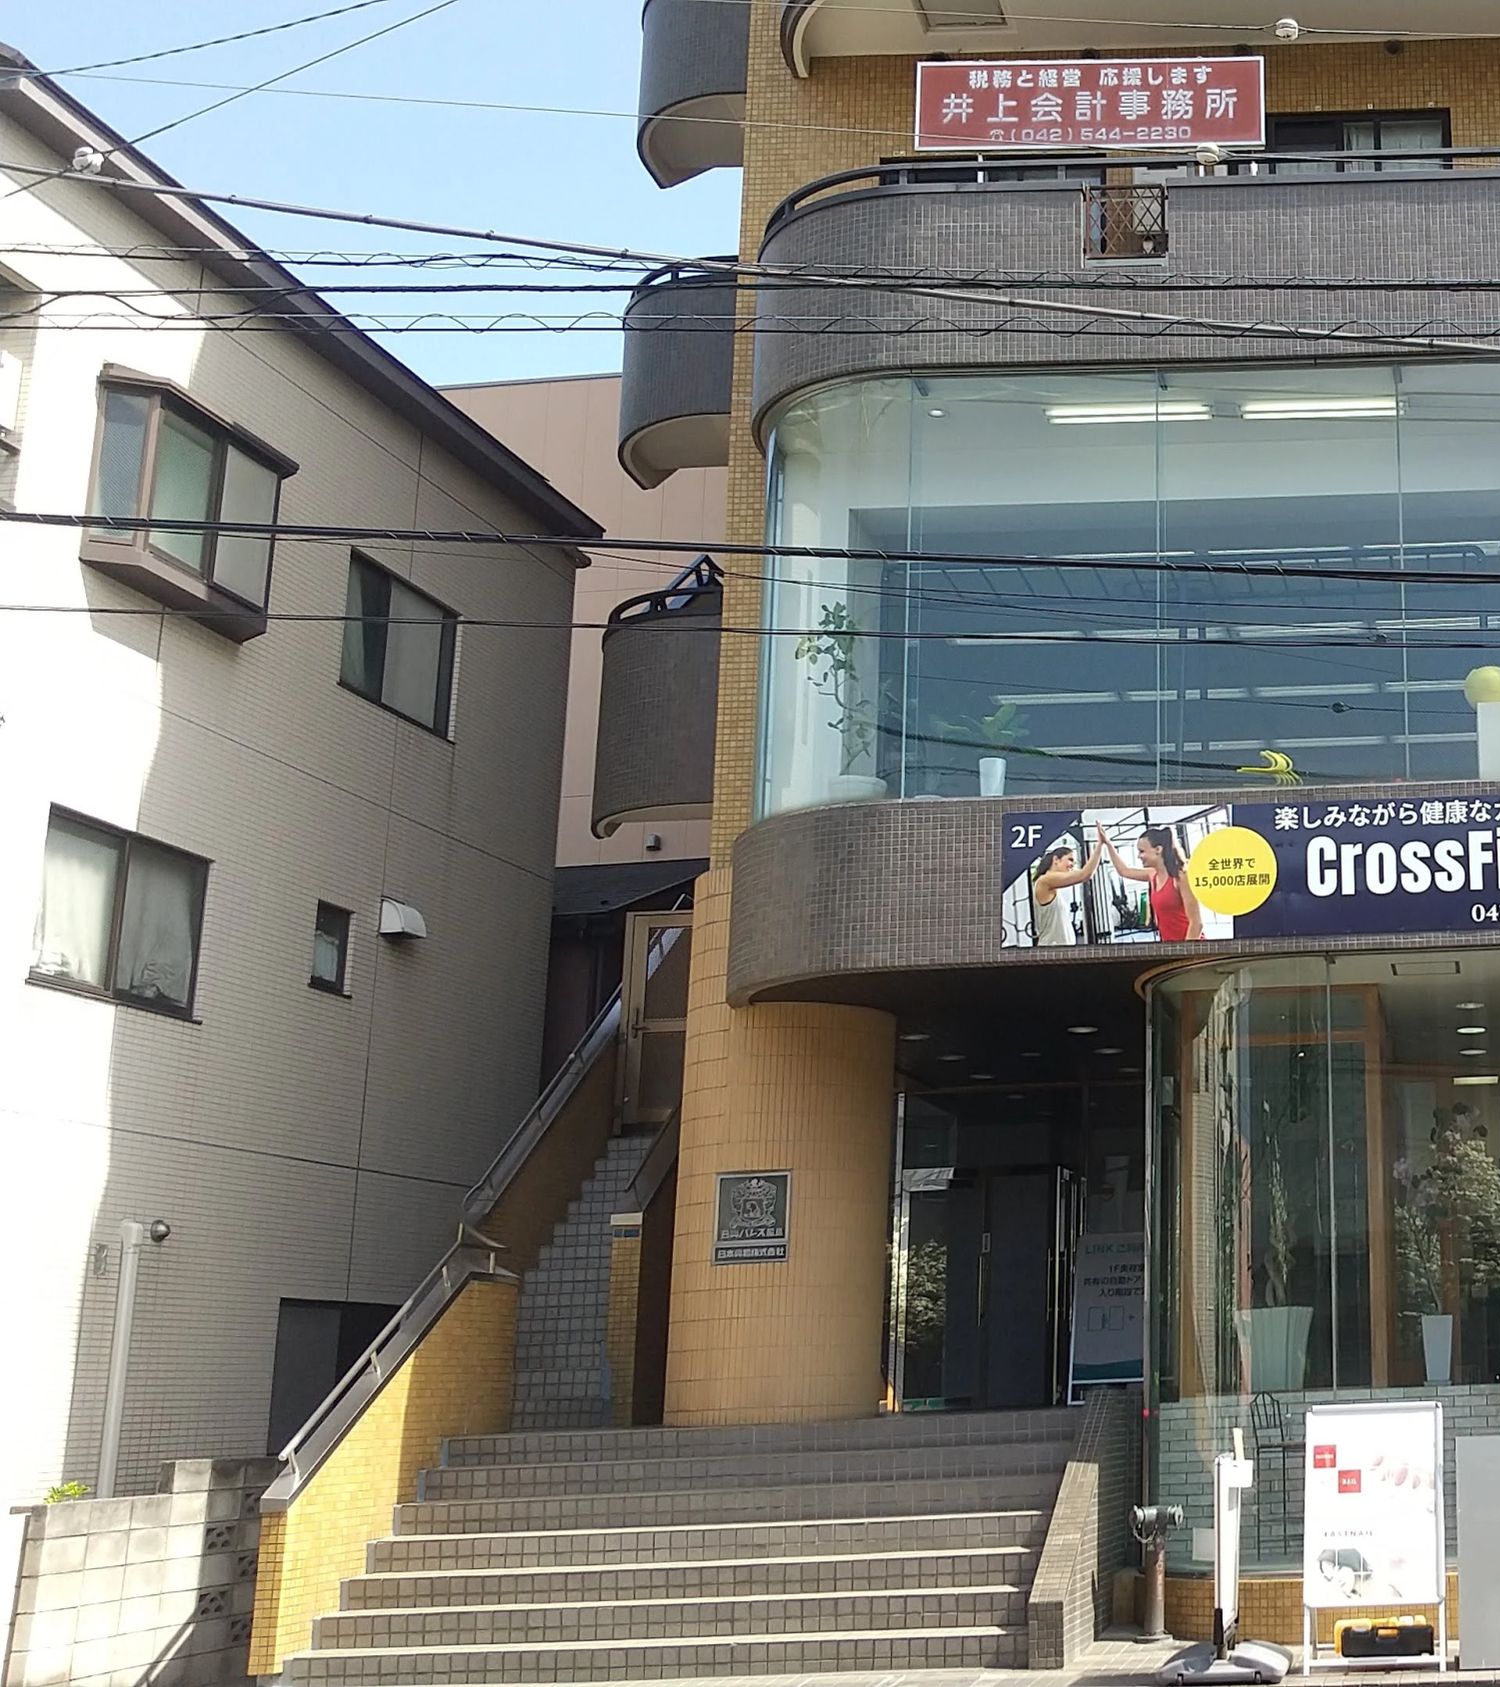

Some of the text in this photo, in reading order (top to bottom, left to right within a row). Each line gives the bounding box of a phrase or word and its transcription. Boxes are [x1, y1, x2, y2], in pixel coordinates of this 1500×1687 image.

[969, 66, 1213, 89] 税務と経営 応援します
[942, 88, 1239, 124] 井上会計事務所
[1010, 824, 1043, 849] 2F
[1208, 857, 1257, 872] 全世界で
[1194, 873, 1272, 890] 15,000店展開
